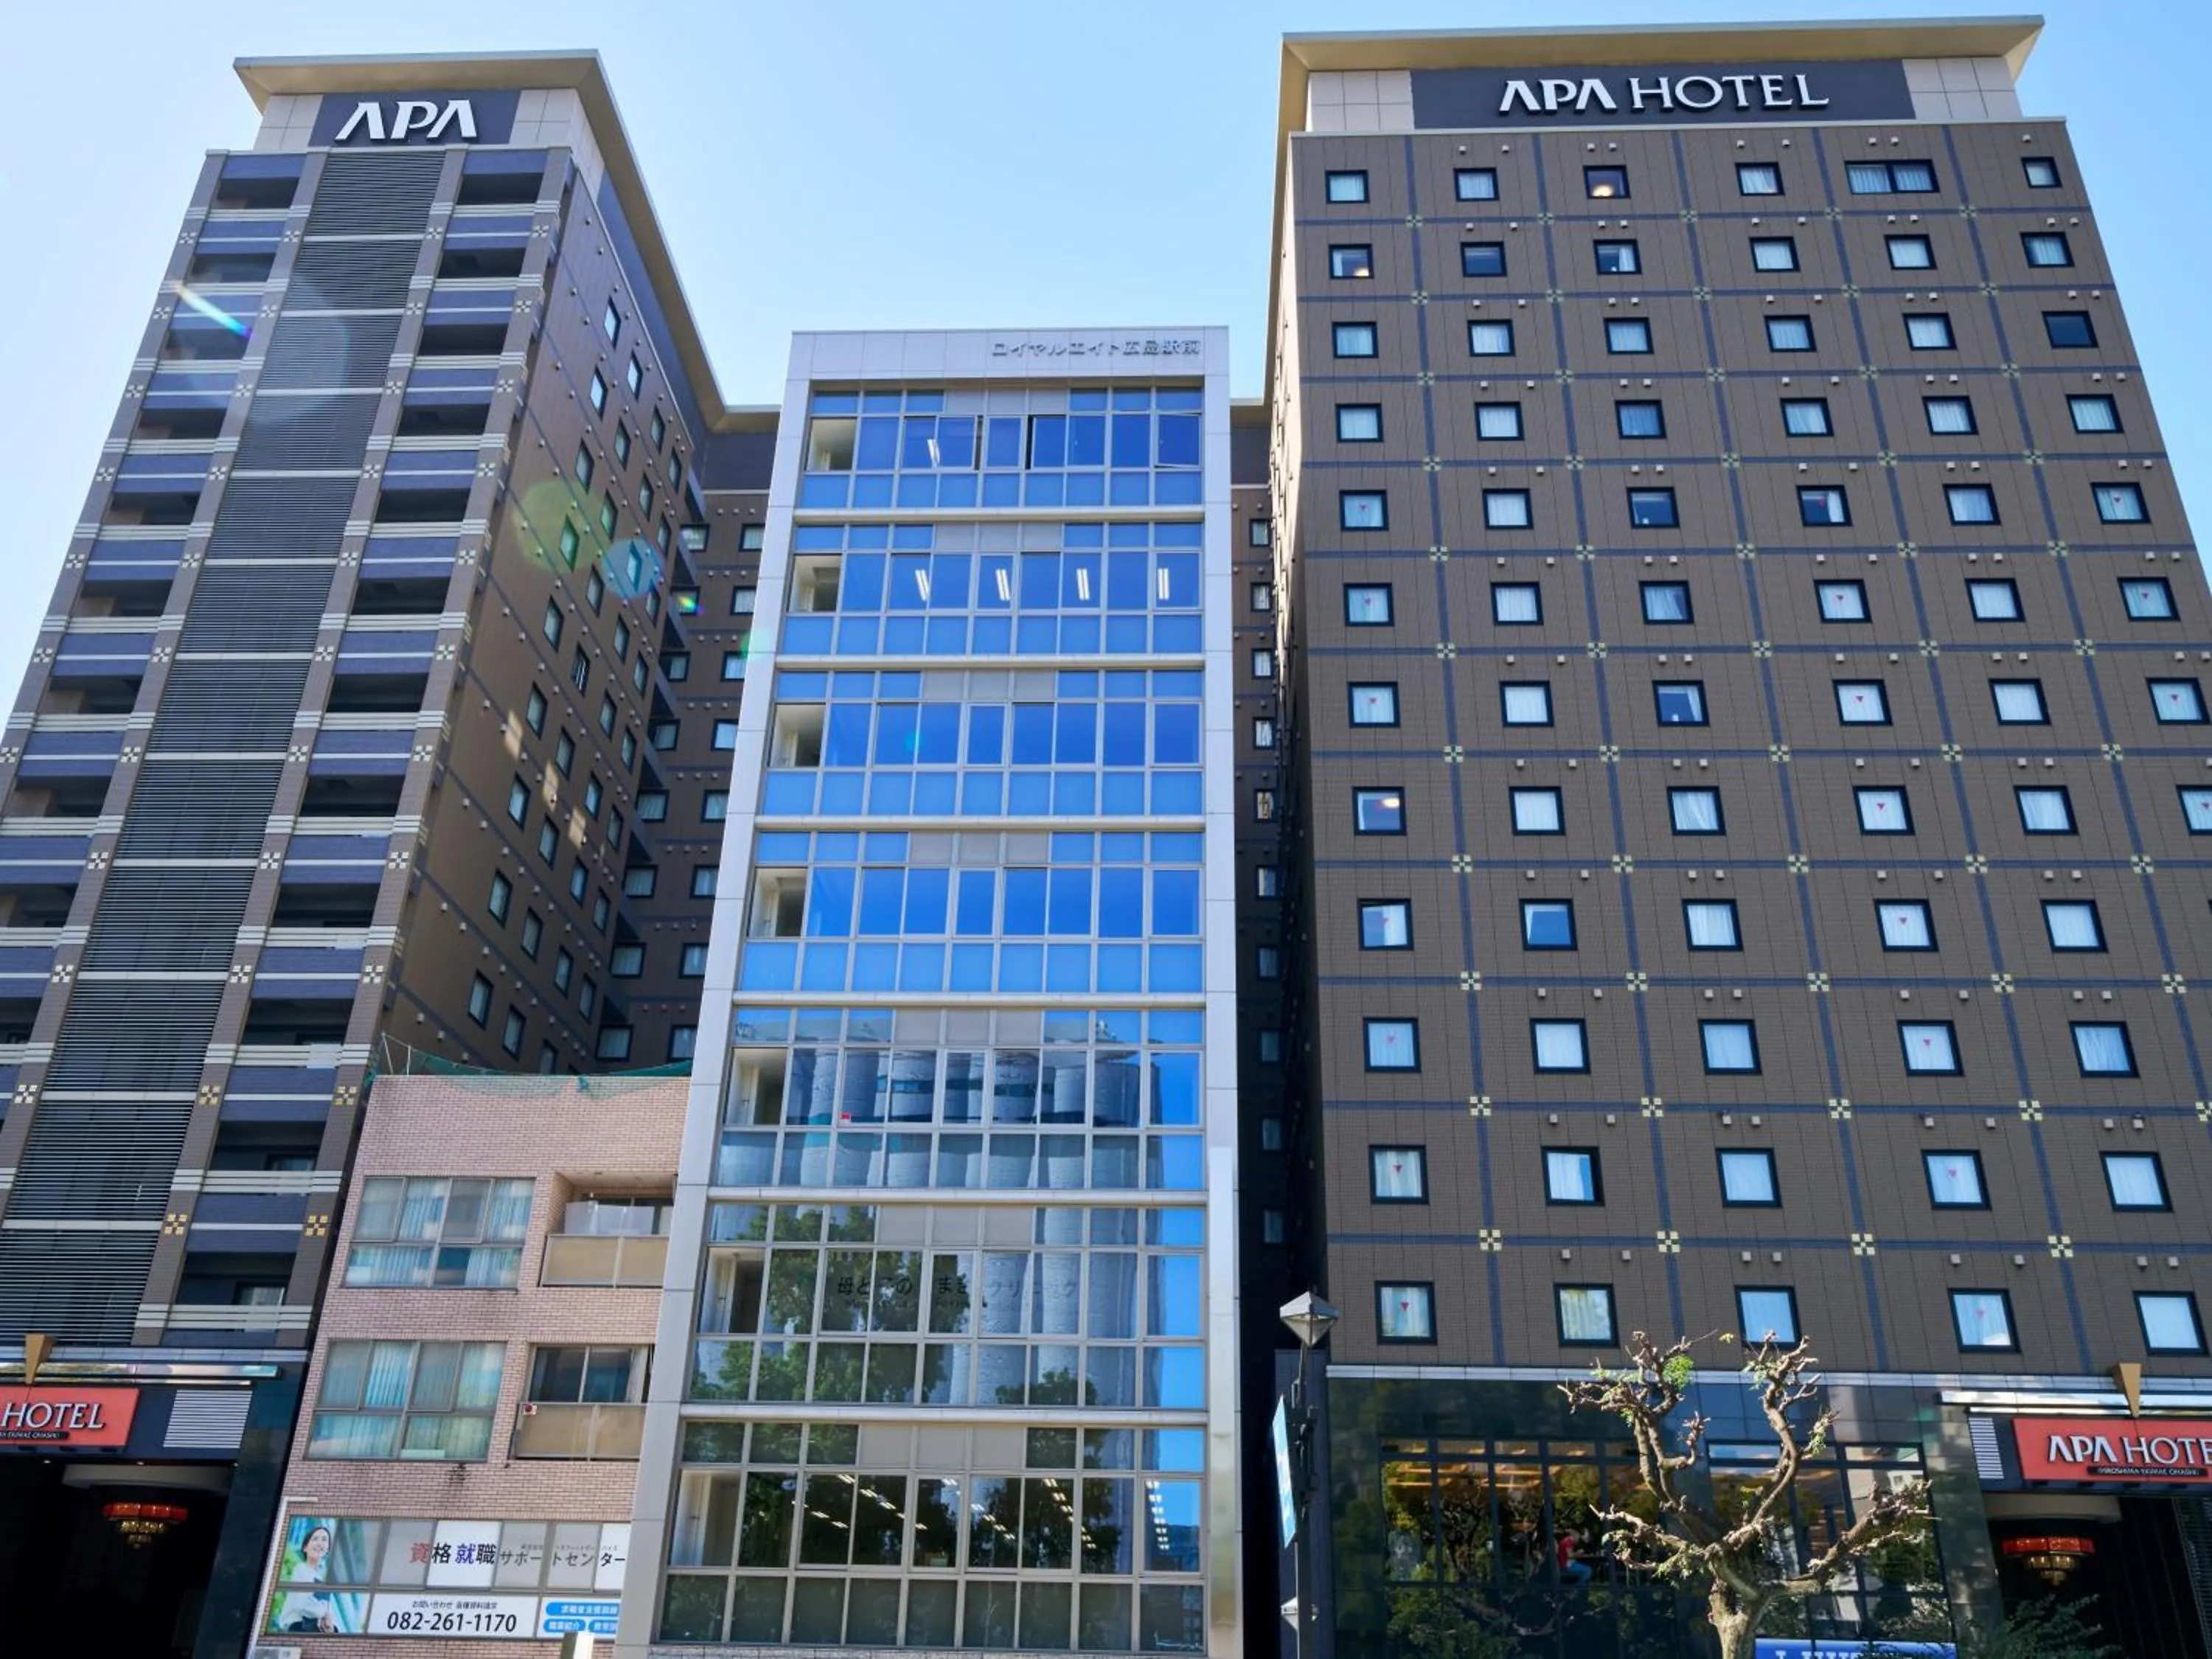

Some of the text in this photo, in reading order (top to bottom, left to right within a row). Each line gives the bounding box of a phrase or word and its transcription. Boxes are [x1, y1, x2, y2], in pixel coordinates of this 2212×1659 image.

[1500, 74, 1829, 112] APA HOTEL
[334, 99, 479, 142] APA
[0, 1402, 105, 1428] HOTEL
[2049, 1435, 2118, 1463] APA
[387, 1611, 517, 1633] 082-261-1170
